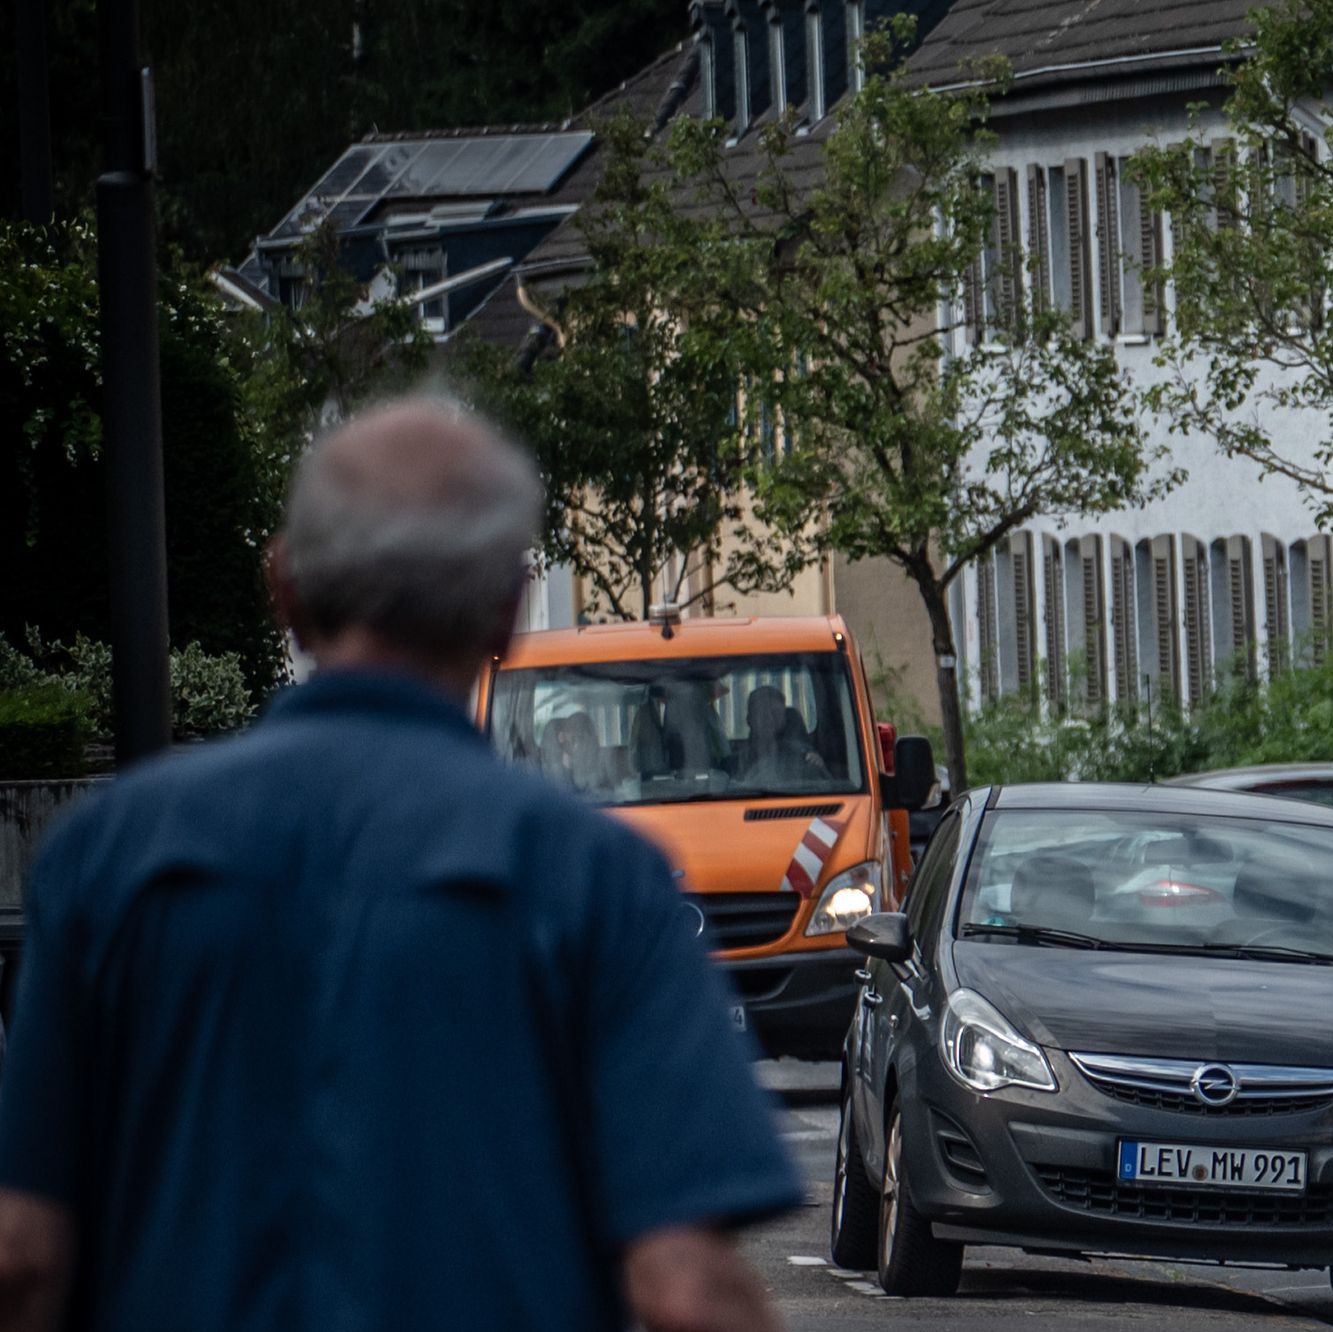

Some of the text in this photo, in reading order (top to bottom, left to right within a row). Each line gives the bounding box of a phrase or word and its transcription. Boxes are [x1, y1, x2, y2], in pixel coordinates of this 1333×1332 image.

[1124, 1147, 1301, 1184] D LEV MW 991
